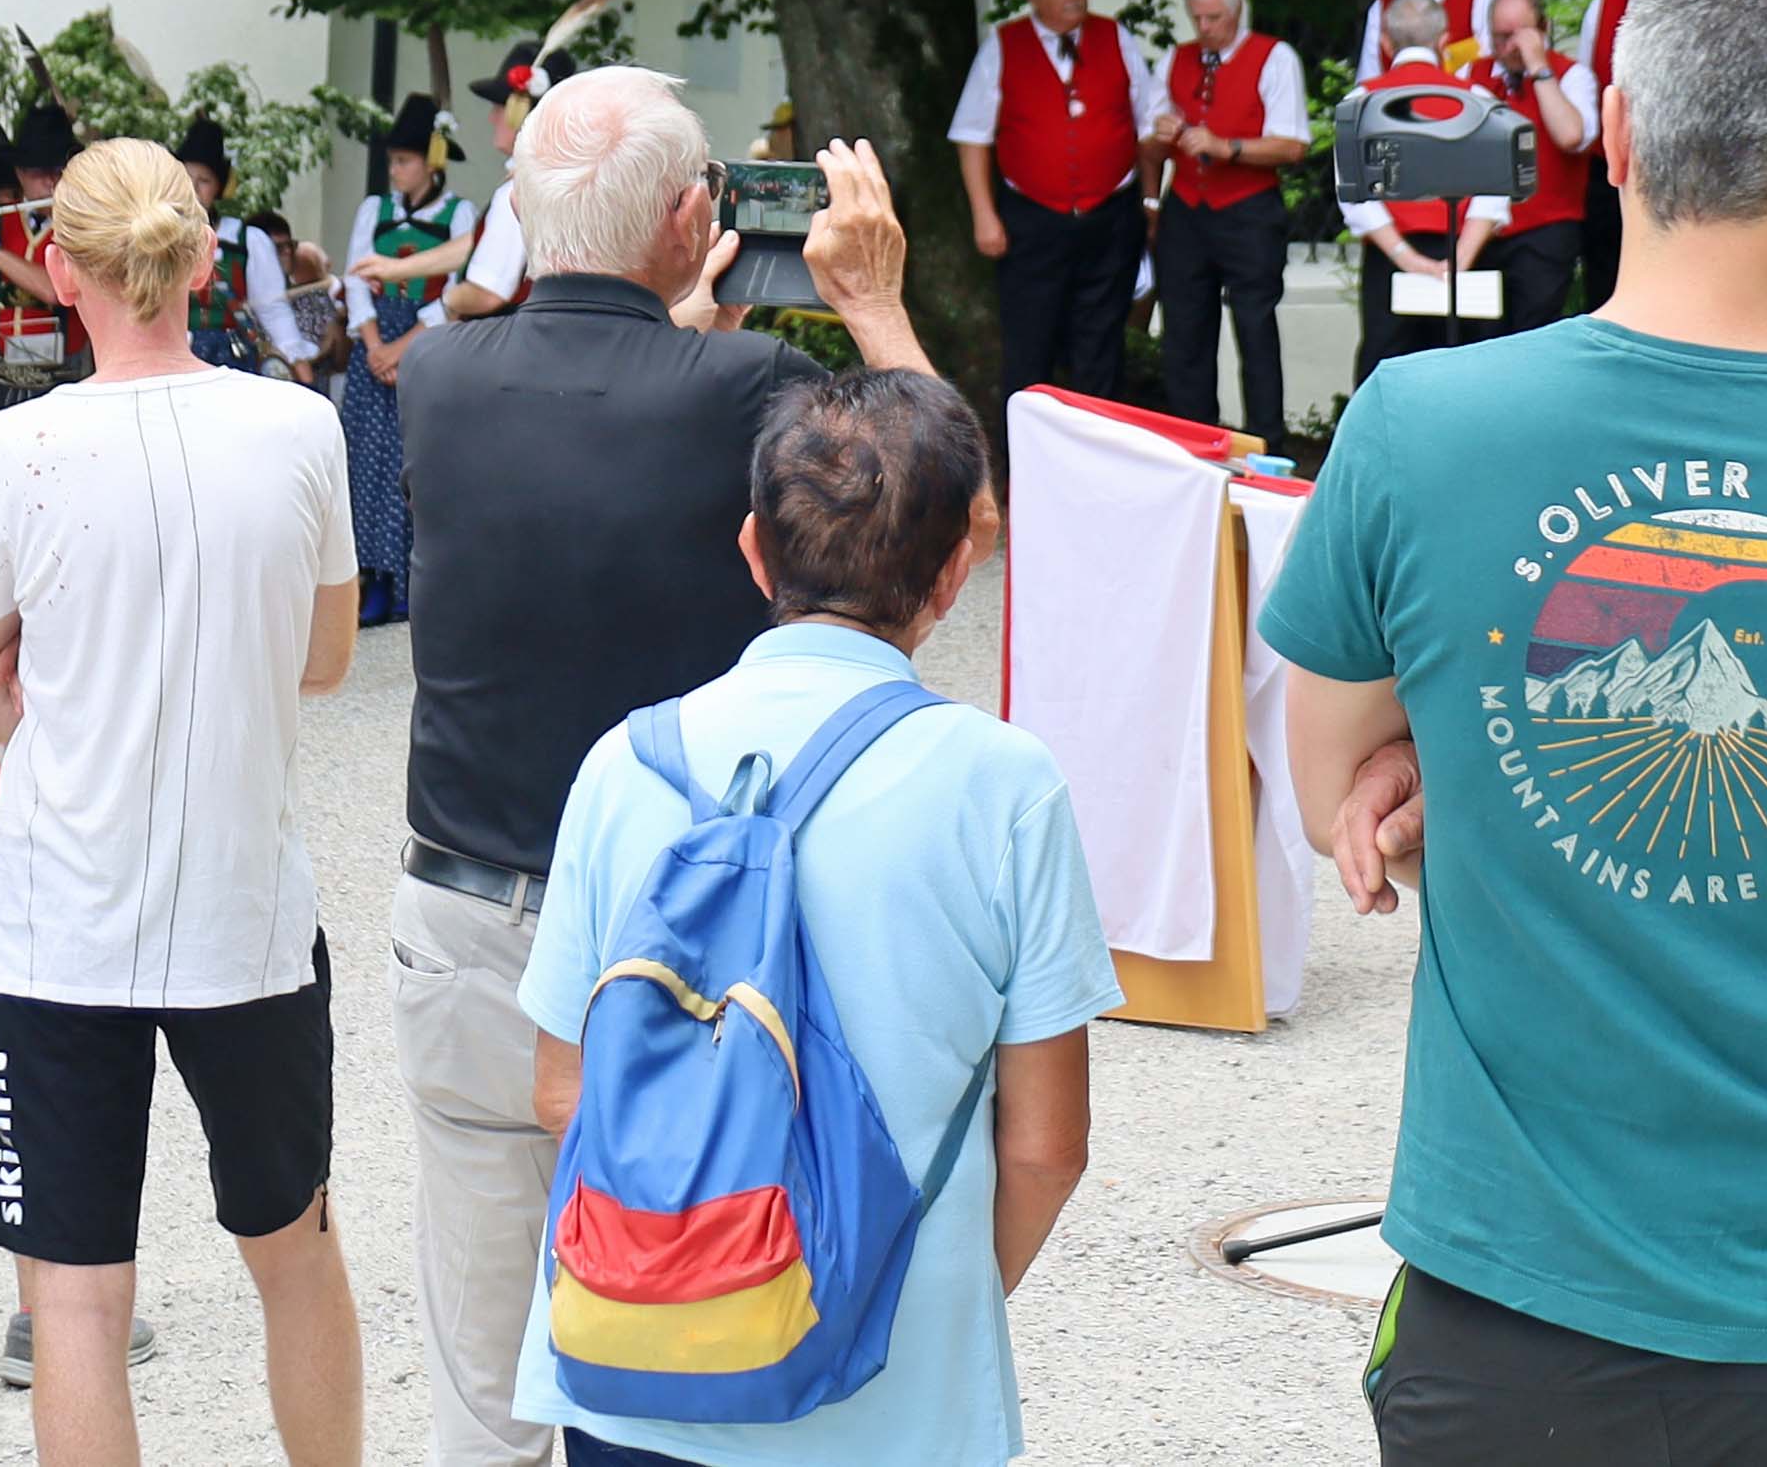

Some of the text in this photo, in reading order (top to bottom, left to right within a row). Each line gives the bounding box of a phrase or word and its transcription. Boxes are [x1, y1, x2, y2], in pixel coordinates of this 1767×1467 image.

[1514, 460, 1751, 582] S.OLIVER
[1734, 628, 1764, 645] Est.
[1480, 685, 1651, 900] MOUNTAINS
[1669, 873, 1758, 904] ARE
